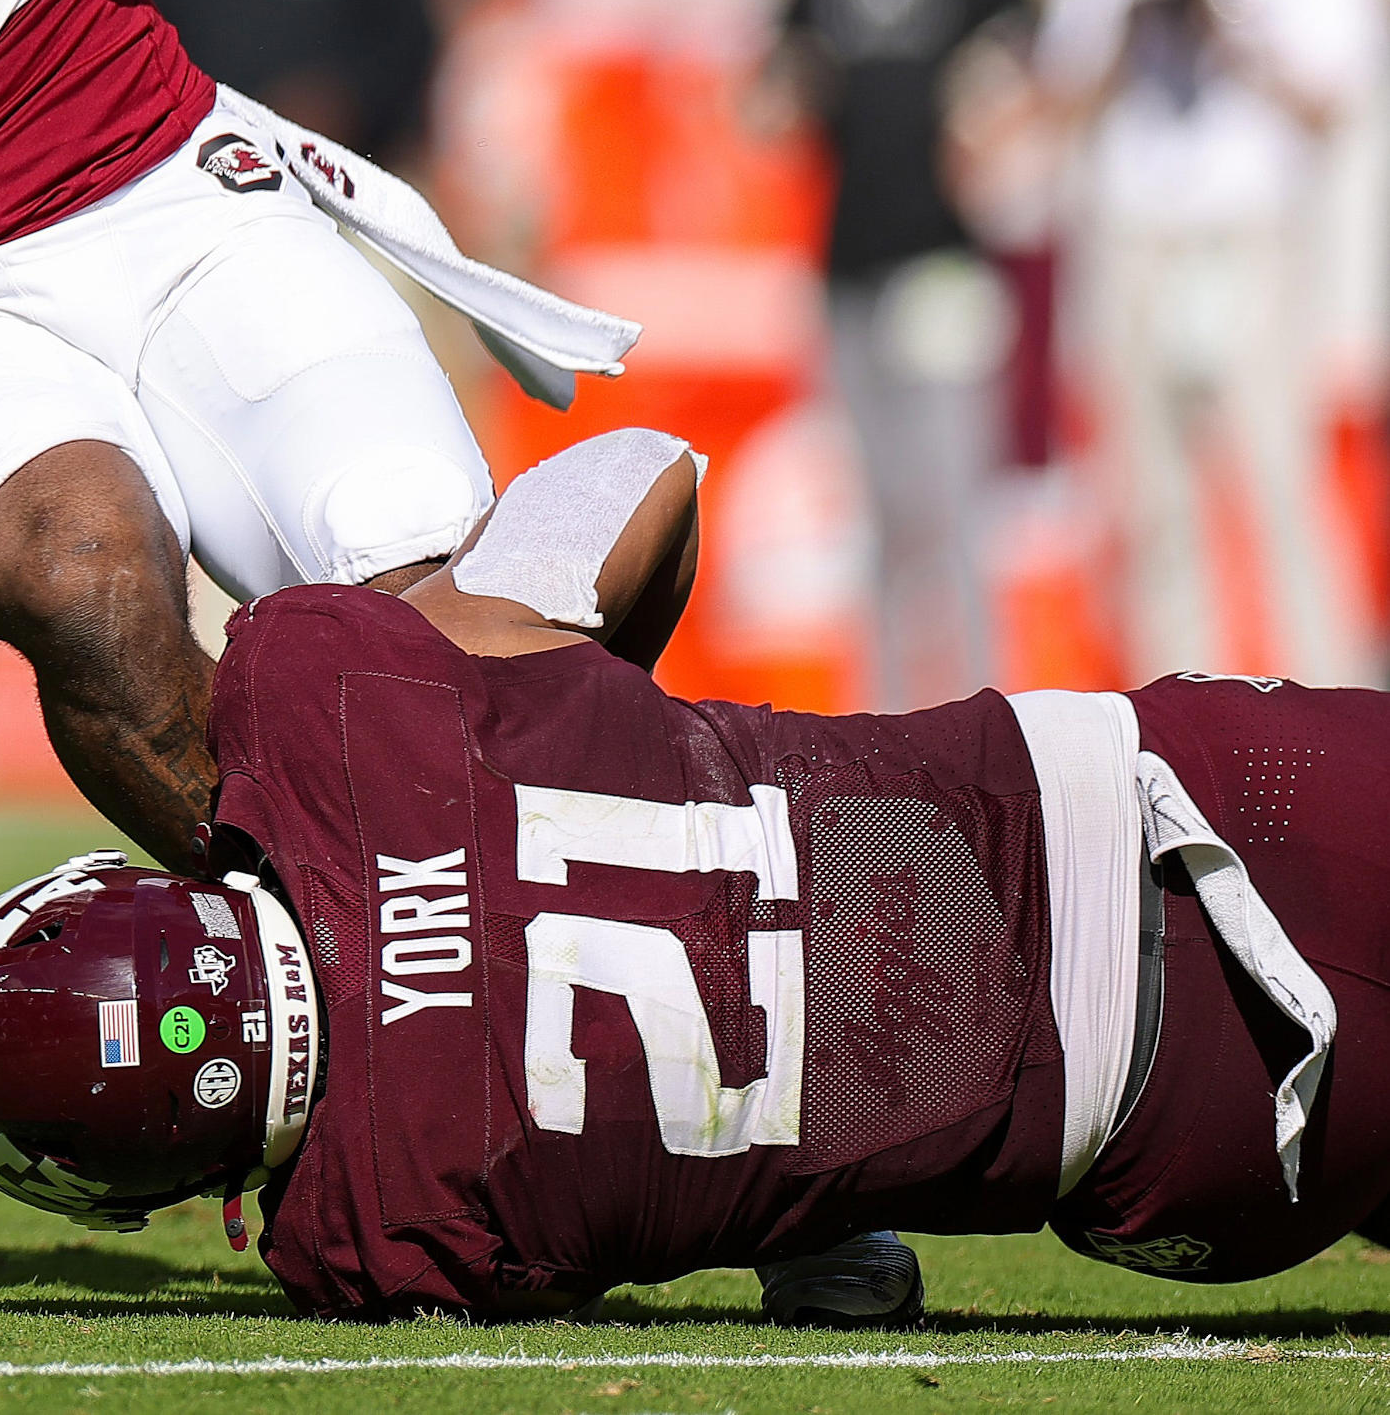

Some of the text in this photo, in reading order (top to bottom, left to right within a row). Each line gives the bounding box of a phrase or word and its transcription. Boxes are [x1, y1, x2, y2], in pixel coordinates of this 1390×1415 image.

[376, 847, 474, 1026] YORK
[515, 784, 805, 1158] 21
[173, 1011, 190, 1049] C2P
[241, 1009, 268, 1043] 21
[275, 943, 311, 1125] TEXAS A&M
[194, 1062, 240, 1105] SEC
